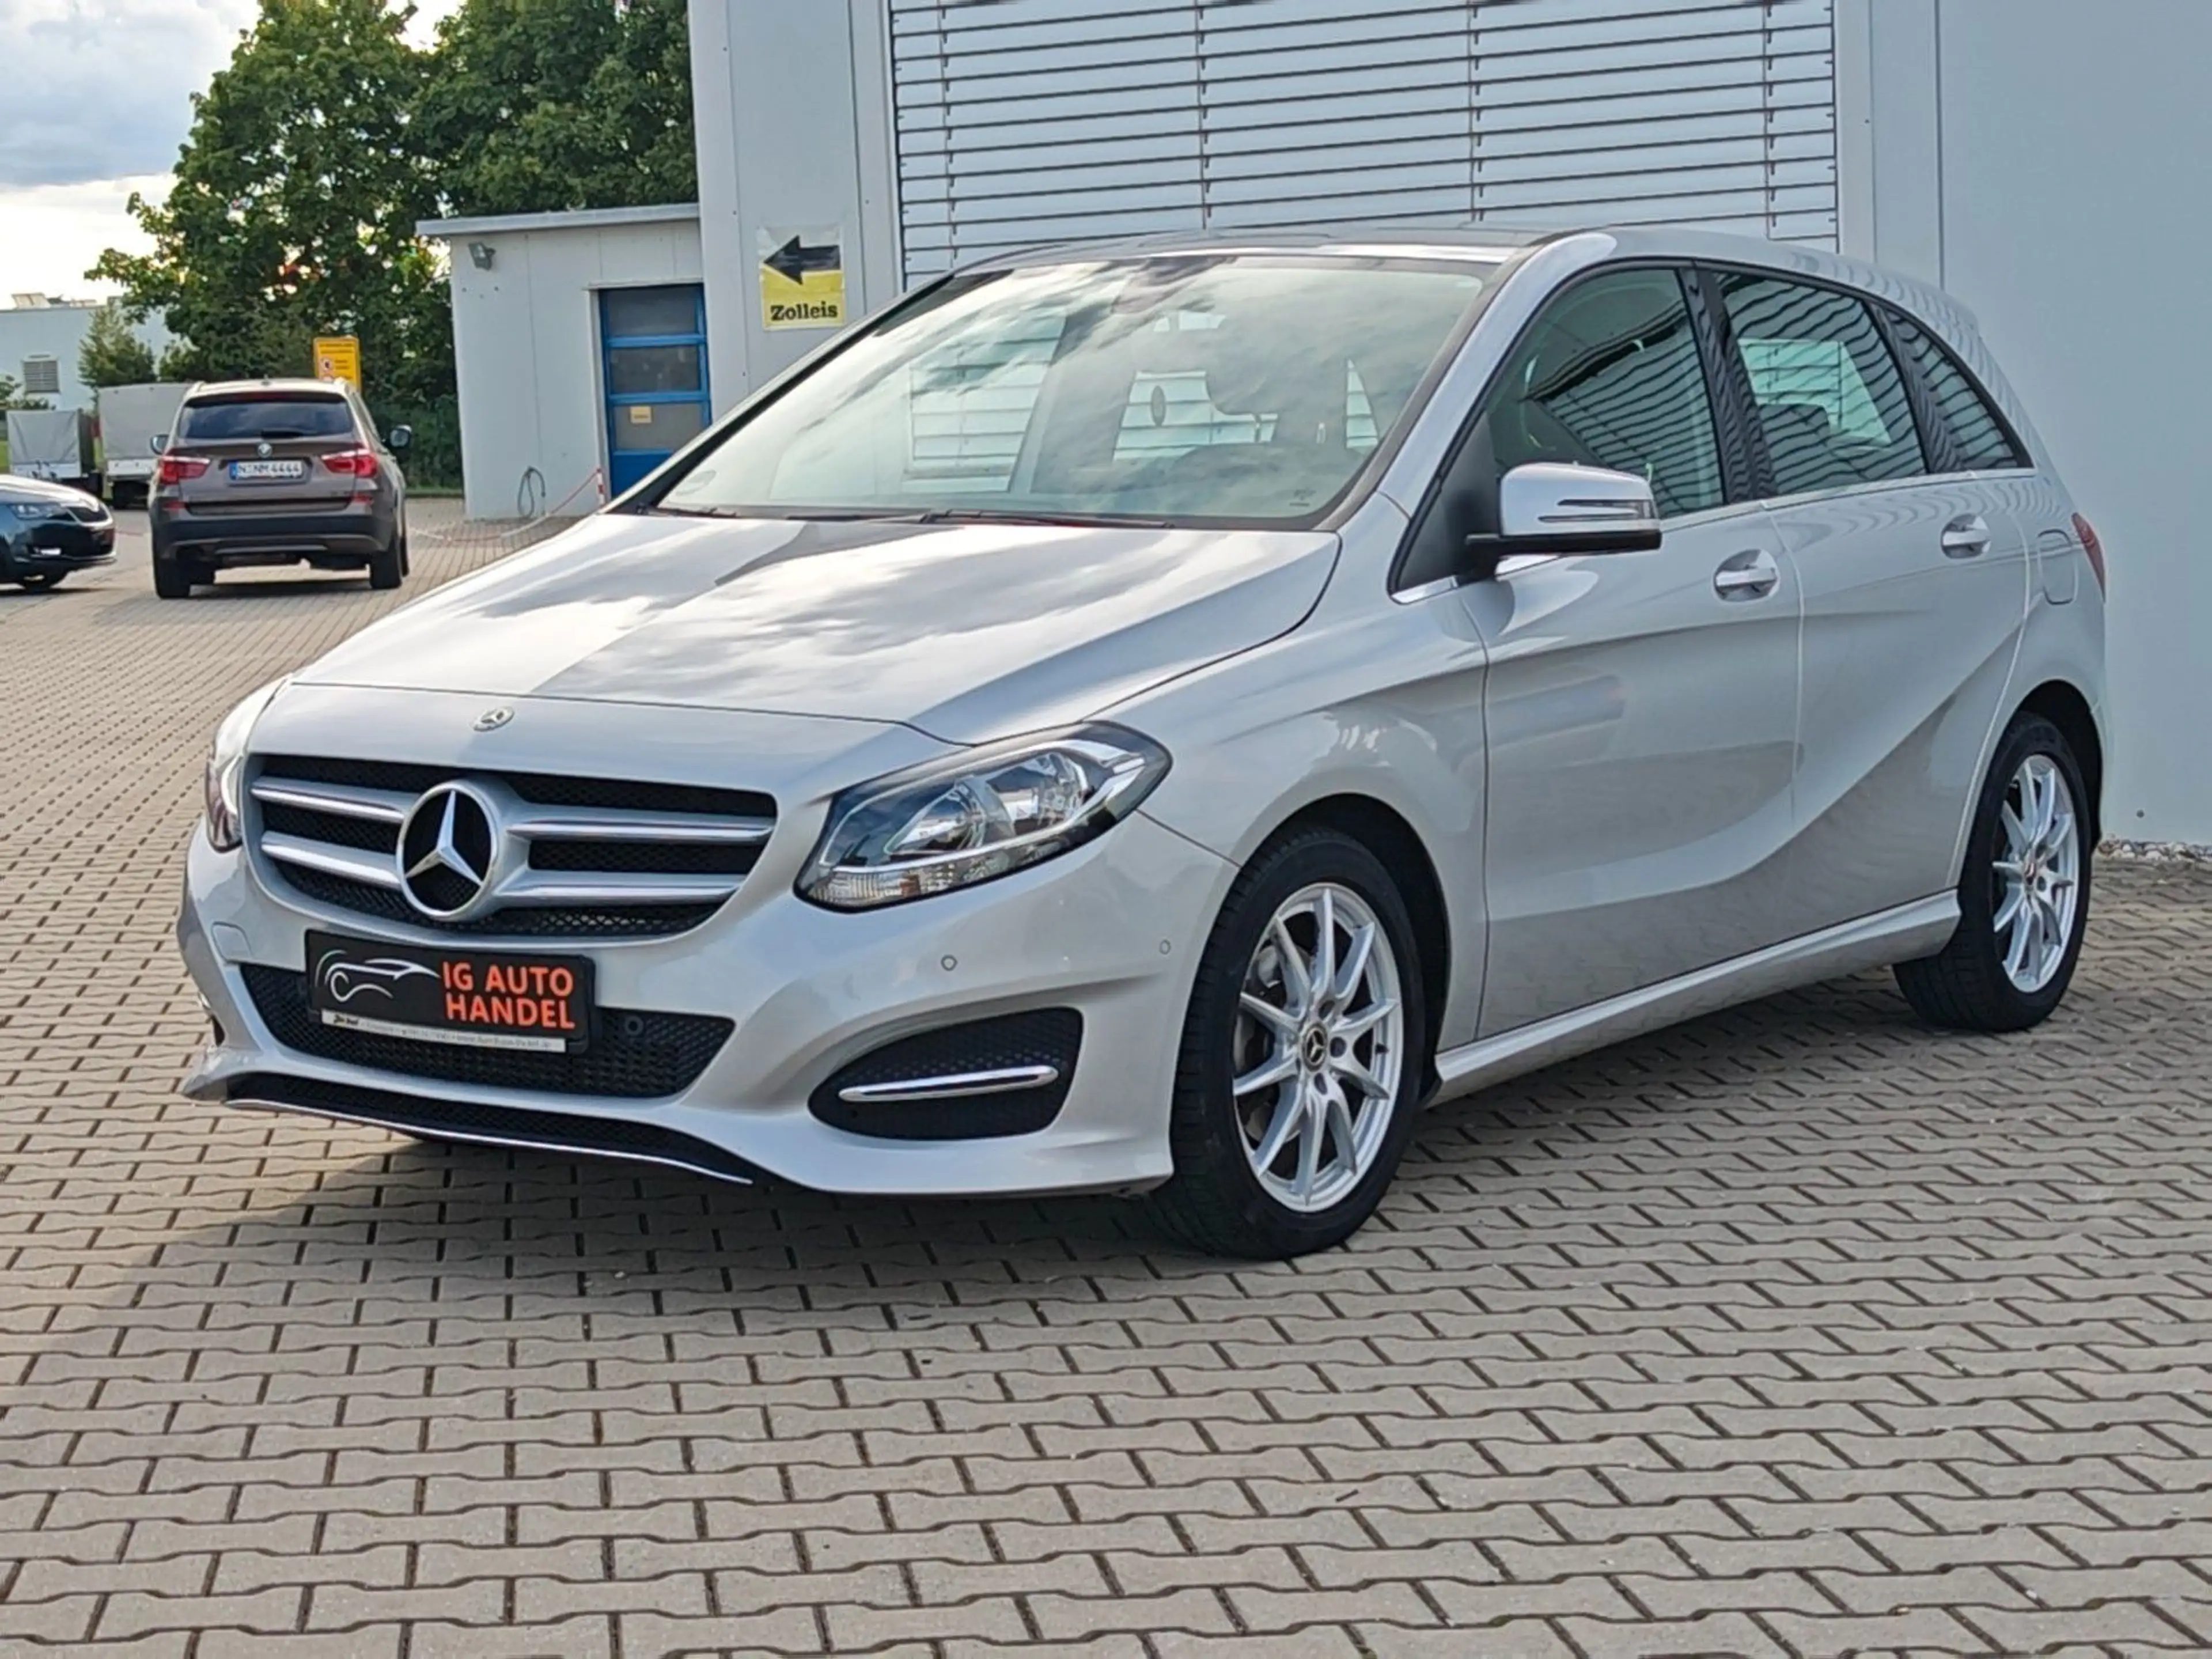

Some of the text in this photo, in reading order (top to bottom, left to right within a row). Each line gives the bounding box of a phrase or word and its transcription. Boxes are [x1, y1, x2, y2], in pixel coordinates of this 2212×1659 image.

[770, 301, 838, 321] Zolleis
[443, 961, 574, 997] IG AUTO
[446, 992, 575, 1029] HANDEL
